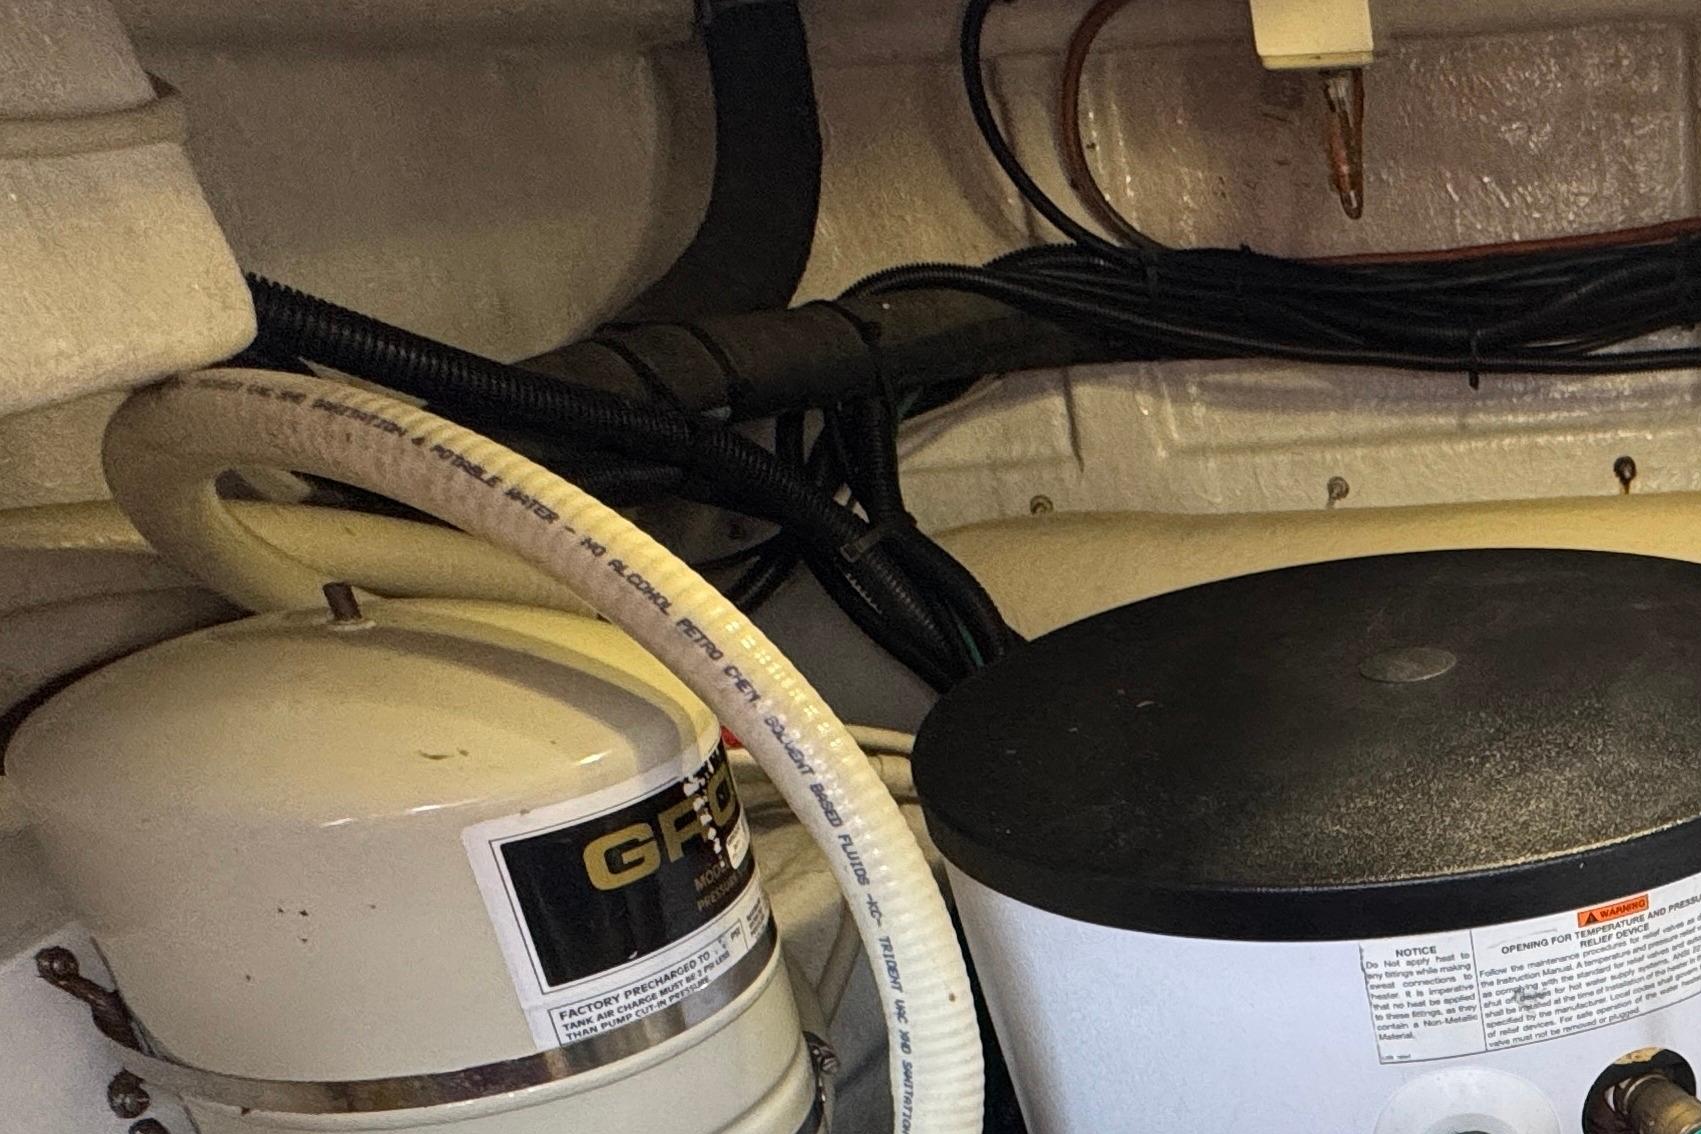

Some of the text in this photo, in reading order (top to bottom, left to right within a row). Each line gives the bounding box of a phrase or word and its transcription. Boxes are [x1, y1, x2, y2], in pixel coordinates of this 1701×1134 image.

[504, 486, 559, 523] WATER
[580, 538, 606, 556] NO
[608, 559, 672, 615] ALCOHOL
[676, 618, 723, 661] PETRO
[765, 716, 814, 777] SOLVENT
[810, 783, 844, 828] BASED
[838, 833, 869, 886] FLUIDS
[878, 935, 904, 993] TRIDENT
[1600, 900, 1645, 918] WARNING
[1502, 939, 1549, 954] OPENING
[1552, 934, 1571, 945] FOR
[1574, 914, 1645, 939] TEMPERATURE
[1648, 908, 1666, 919] AND
[1580, 923, 1649, 948] RELIEF DEVICE
[1366, 961, 1378, 969] Do
[1384, 960, 1400, 968] Not
[1406, 958, 1430, 967] apply
[1436, 954, 1455, 962] heat
[1395, 946, 1436, 957] NOTICE
[1416, 967, 1438, 975] while
[1440, 963, 1471, 972] making
[1479, 968, 1507, 977] Follow
[1528, 953, 1579, 968] maintenance
[559, 994, 620, 1021] FACTORY
[624, 959, 696, 999] PRECHARGED
[700, 951, 710, 964] TO
[1403, 976, 1456, 987] connections
[1497, 972, 1540, 985] Instruction
[1429, 984, 1474, 995] imperative
[563, 1017, 592, 1031] TANK
[597, 1009, 615, 1022] AIR
[617, 992, 658, 1014] CHARGE
[660, 980, 684, 996] MUST
[566, 1026, 598, 1040] THAN
[601, 1014, 632, 1030] PUMP
[635, 999, 666, 1017] CUT-IN
